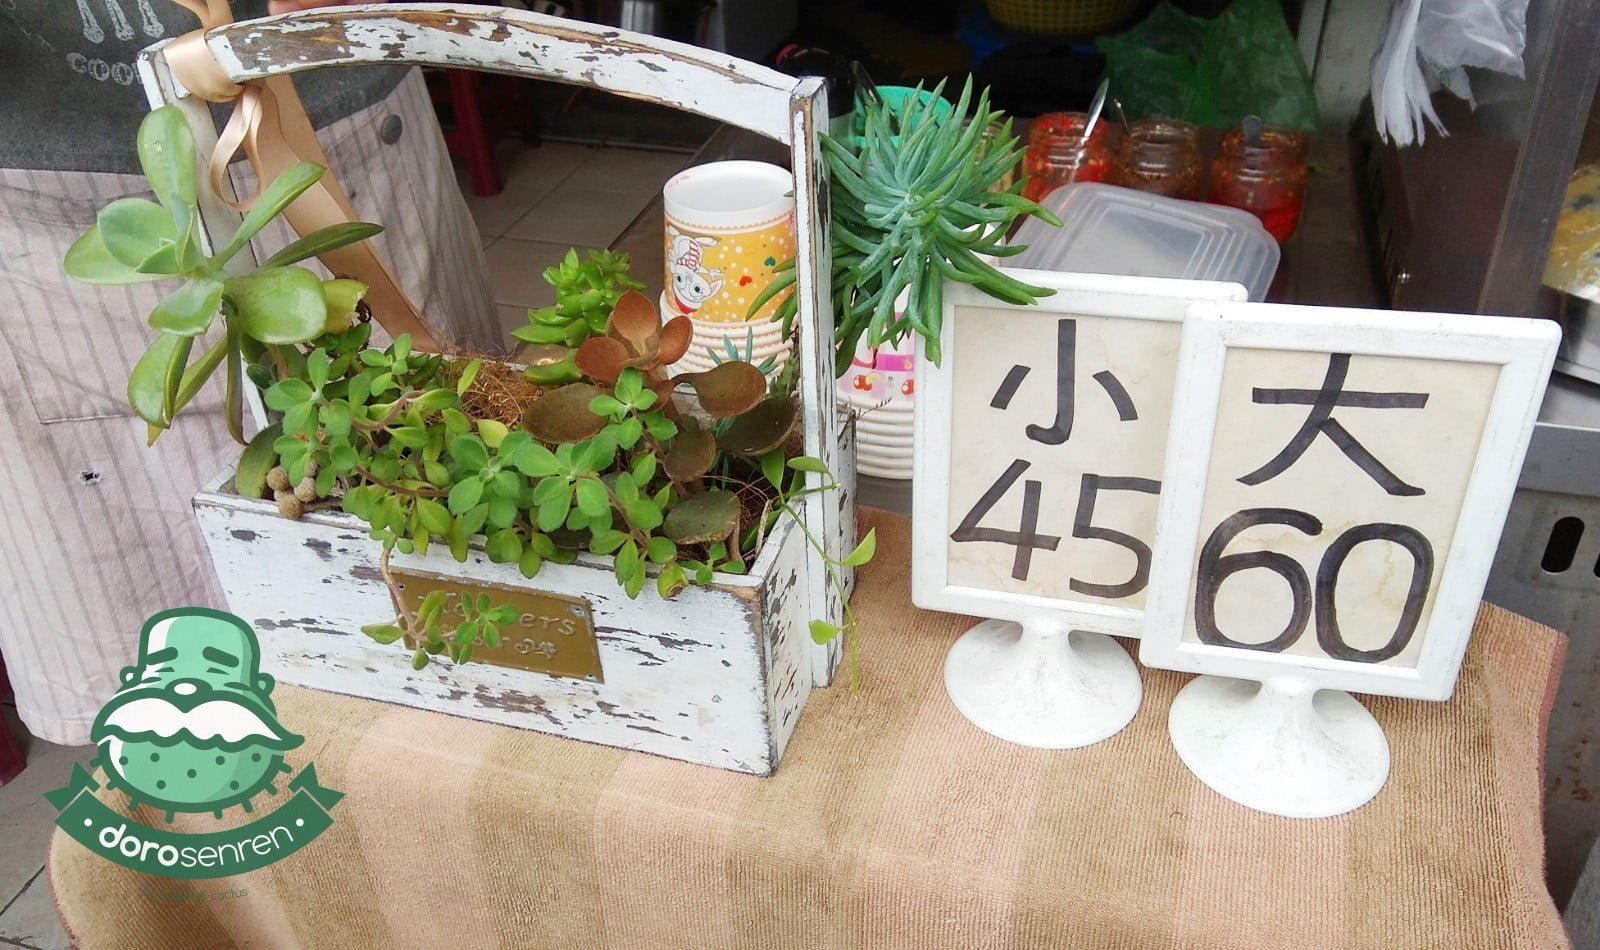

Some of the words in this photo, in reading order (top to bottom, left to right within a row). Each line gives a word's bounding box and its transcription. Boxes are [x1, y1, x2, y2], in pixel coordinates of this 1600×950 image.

[989, 318, 1139, 445] 小
[1236, 352, 1431, 497] 大
[950, 458, 1162, 599] 45
[1194, 507, 1435, 664] 60
